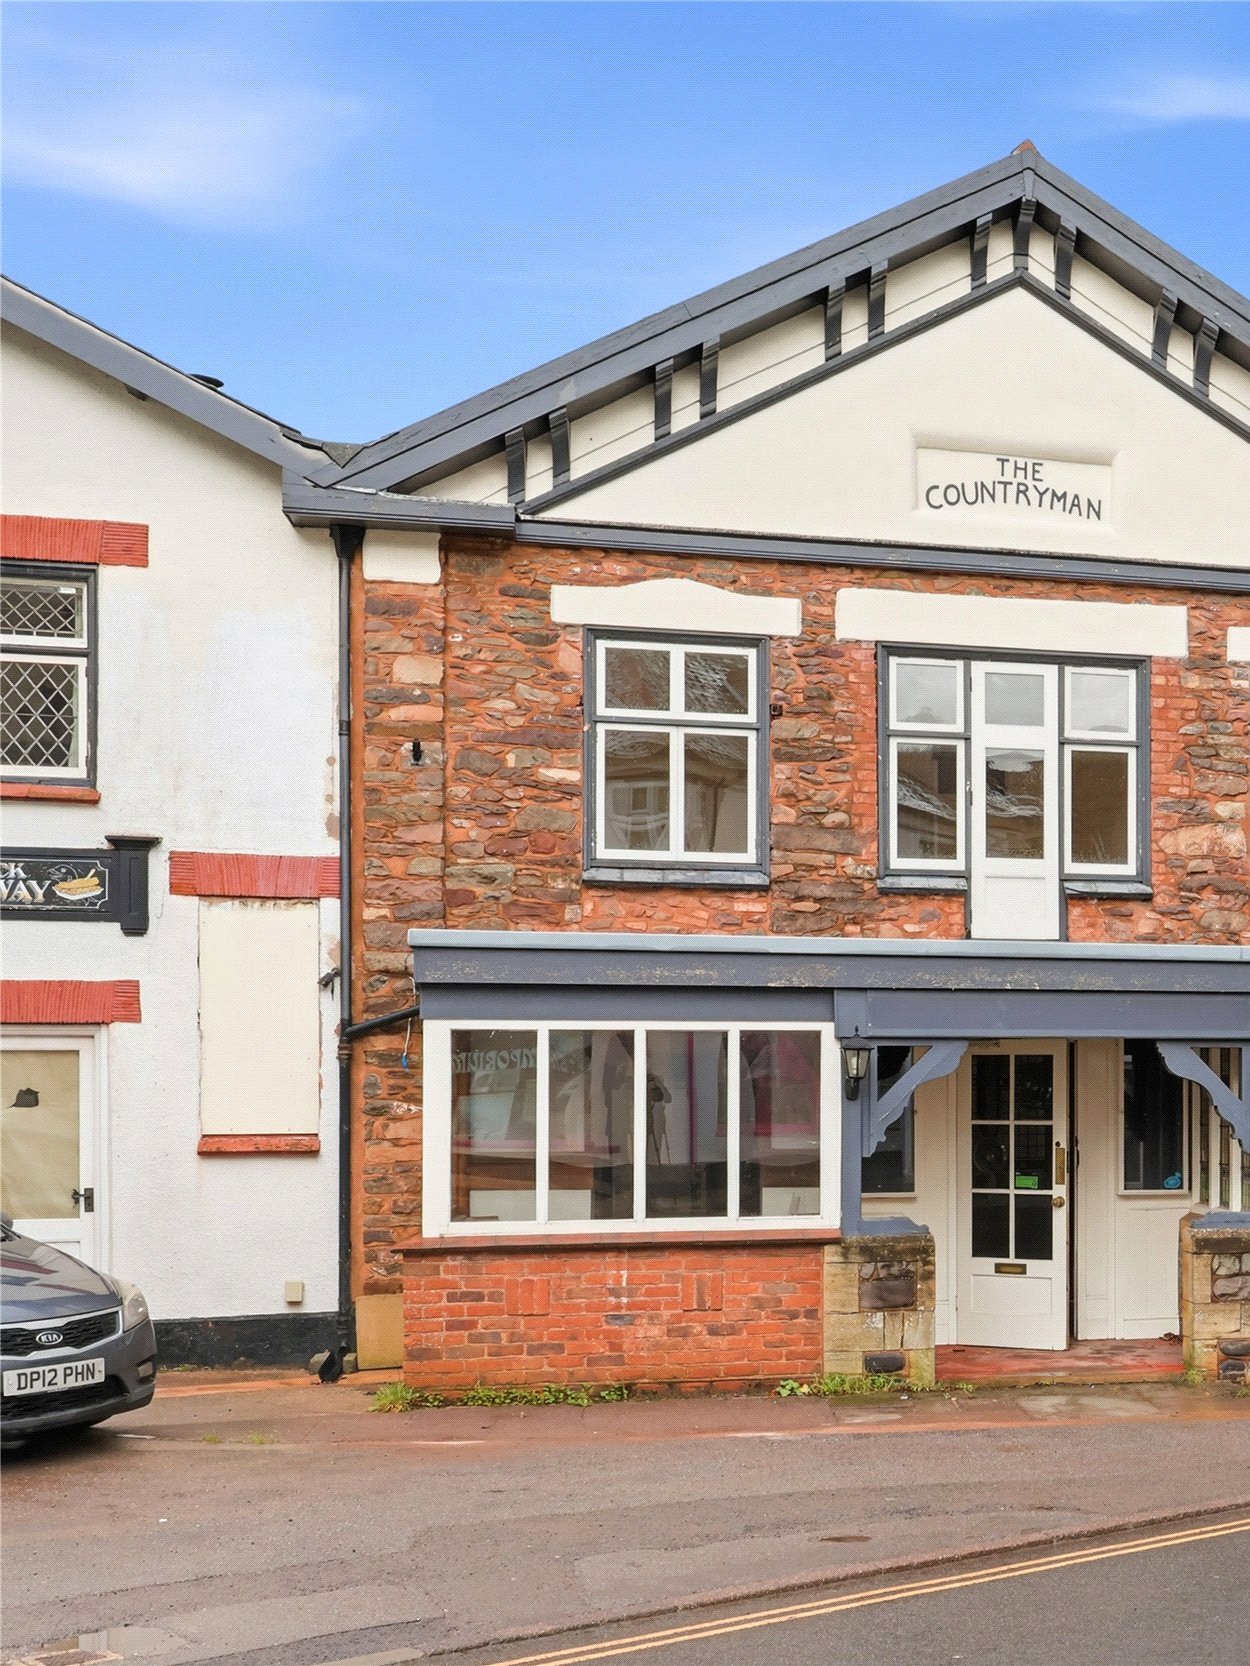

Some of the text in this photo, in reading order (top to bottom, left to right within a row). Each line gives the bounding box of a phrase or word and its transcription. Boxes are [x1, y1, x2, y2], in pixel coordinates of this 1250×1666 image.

[996, 457, 1043, 482] THE
[925, 480, 1101, 521] COUNTRYMAN
[17, 1362, 95, 1391] DP12 PHN
